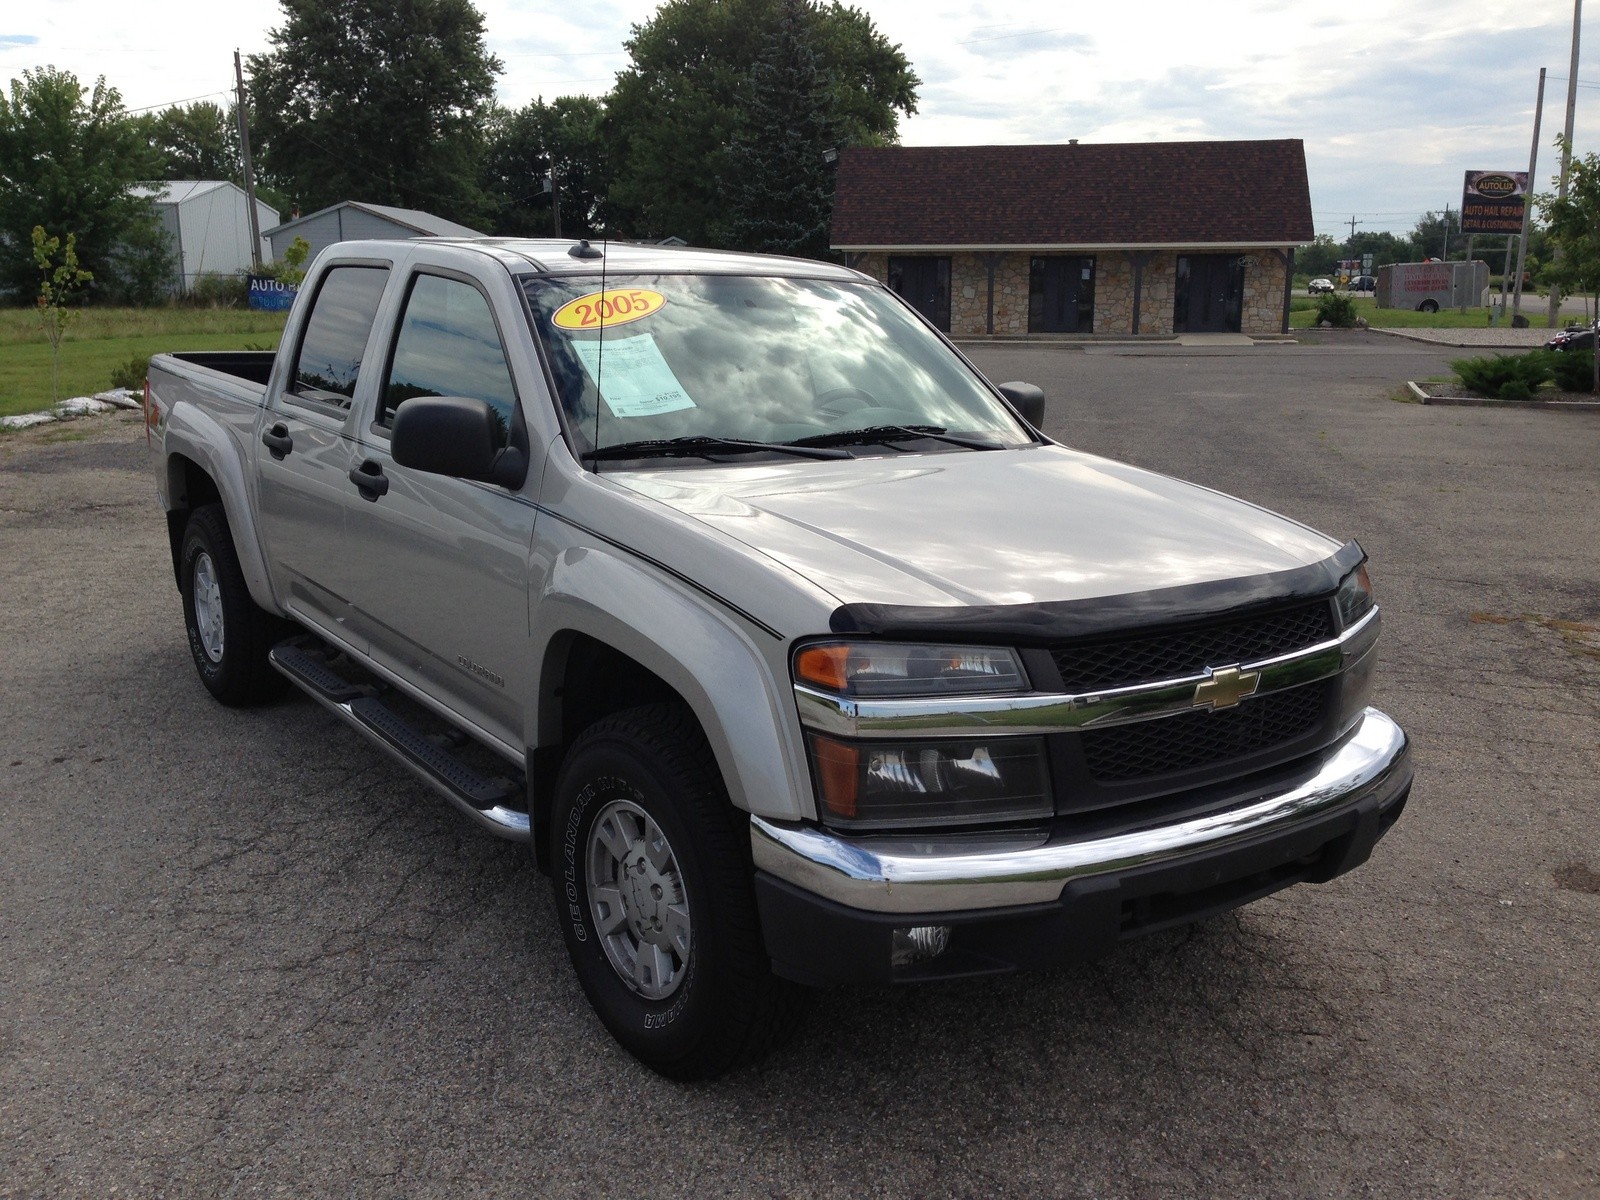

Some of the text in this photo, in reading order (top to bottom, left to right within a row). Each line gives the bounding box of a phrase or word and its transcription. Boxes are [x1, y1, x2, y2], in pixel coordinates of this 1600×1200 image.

[1479, 182, 1514, 190] AUTOLUX
[1464, 205, 1524, 217] AUTO HAIL REPAIR
[1463, 219, 1481, 228] DETAIL
[251, 279, 285, 291] AUTO
[575, 292, 650, 326] 2005
[564, 784, 596, 942] GEOLANDAR
